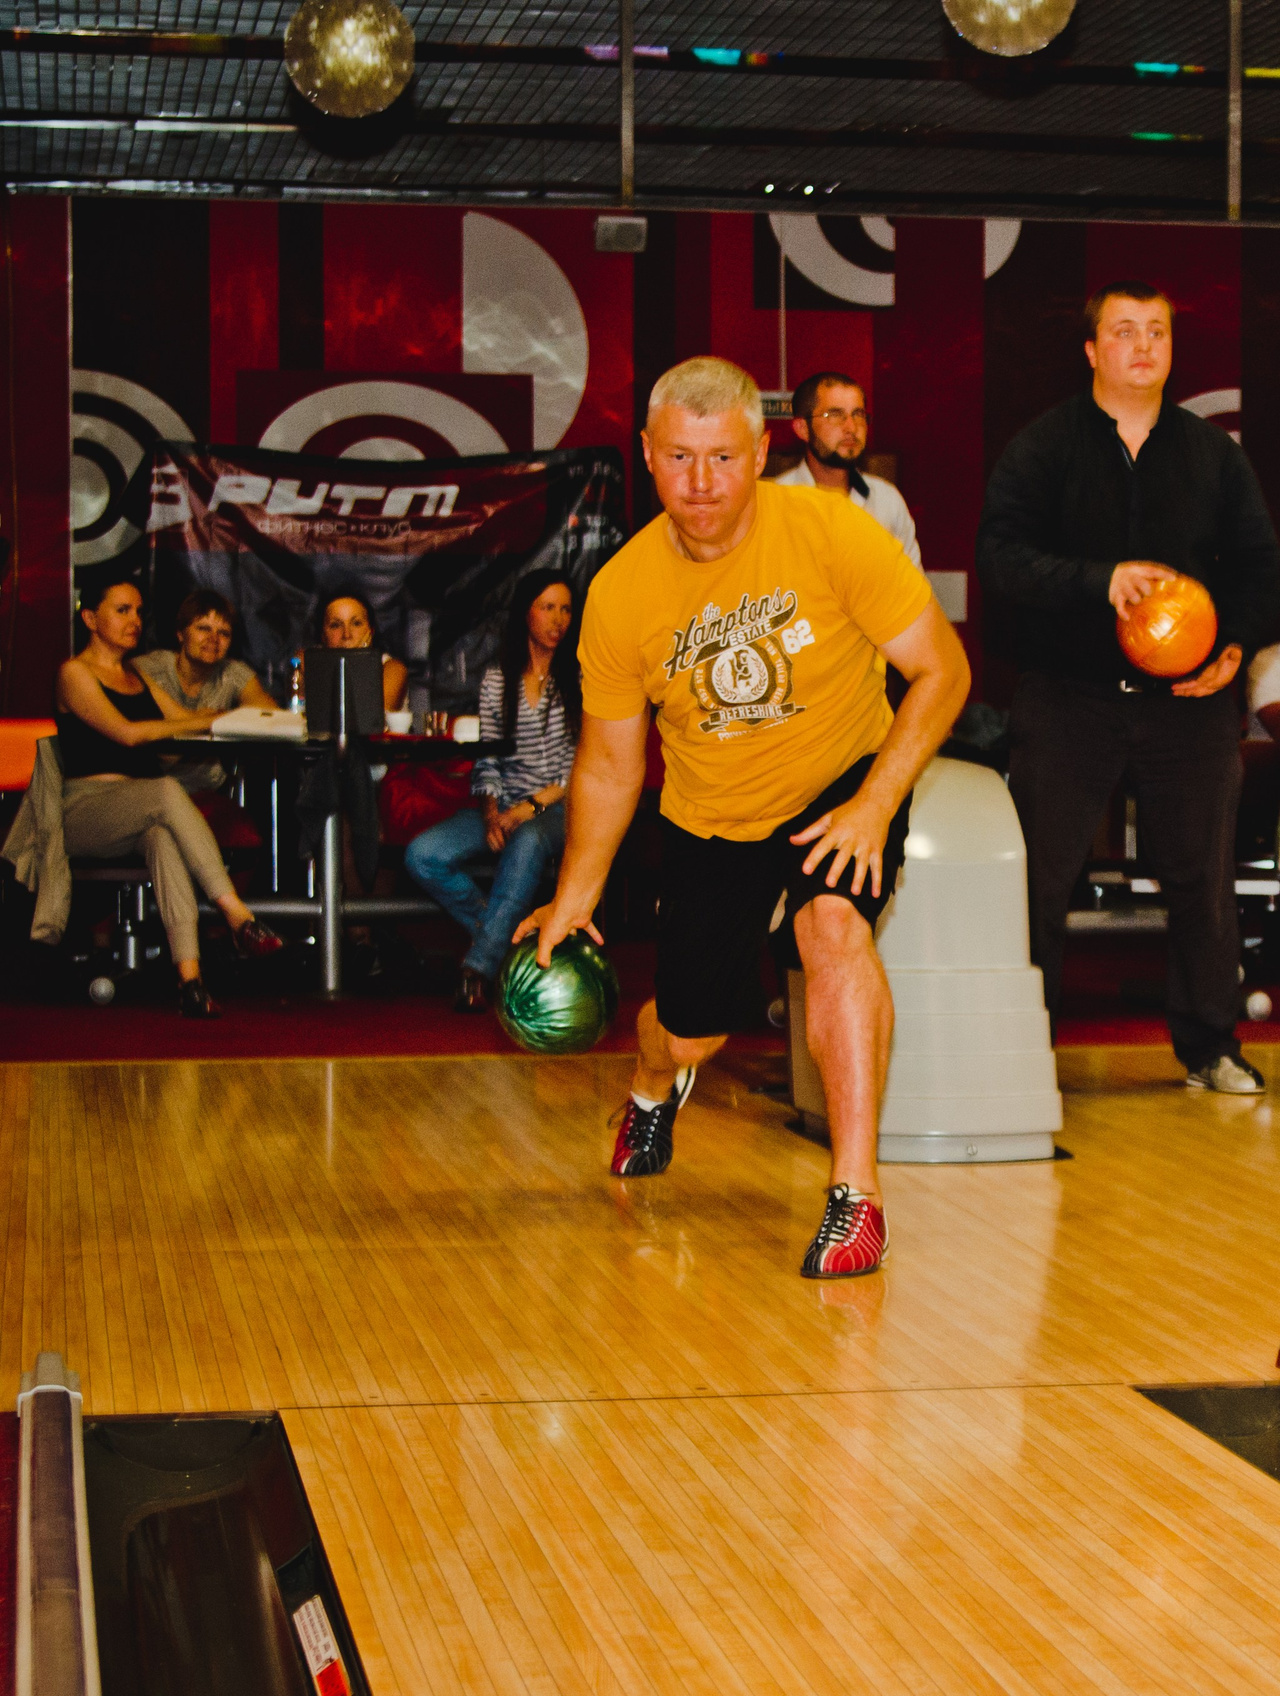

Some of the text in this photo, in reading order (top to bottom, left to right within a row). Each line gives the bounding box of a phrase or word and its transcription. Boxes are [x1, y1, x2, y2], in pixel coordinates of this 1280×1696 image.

[702, 602, 721, 621] the
[663, 587, 797, 679] Hamptons
[729, 620, 773, 647] ESTATE
[781, 618, 815, 654] 62
[719, 704, 783, 721] REFRESHING
